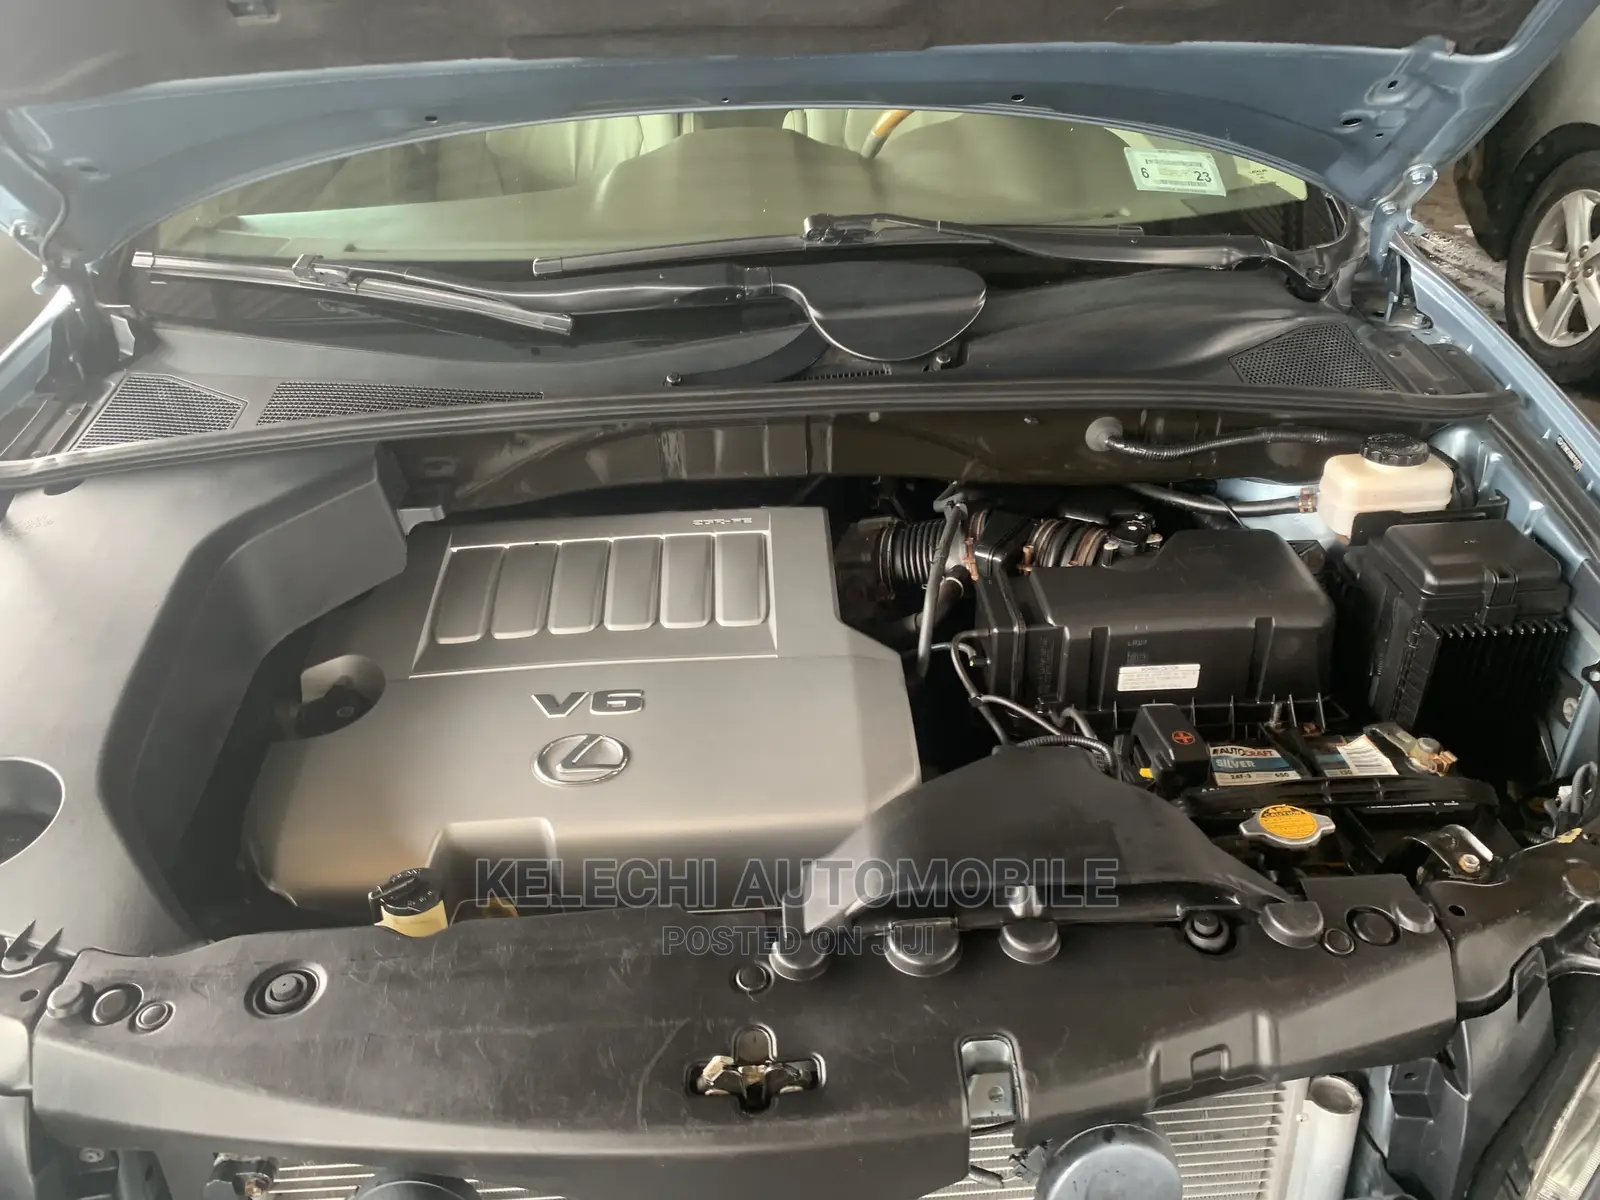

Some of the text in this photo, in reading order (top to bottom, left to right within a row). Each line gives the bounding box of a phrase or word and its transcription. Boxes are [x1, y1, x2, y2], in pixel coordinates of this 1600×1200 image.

[1140, 167, 1150, 179] 6
[1194, 170, 1212, 183] 23
[530, 689, 645, 719] V6
[1215, 758, 1256, 769] SILVER
